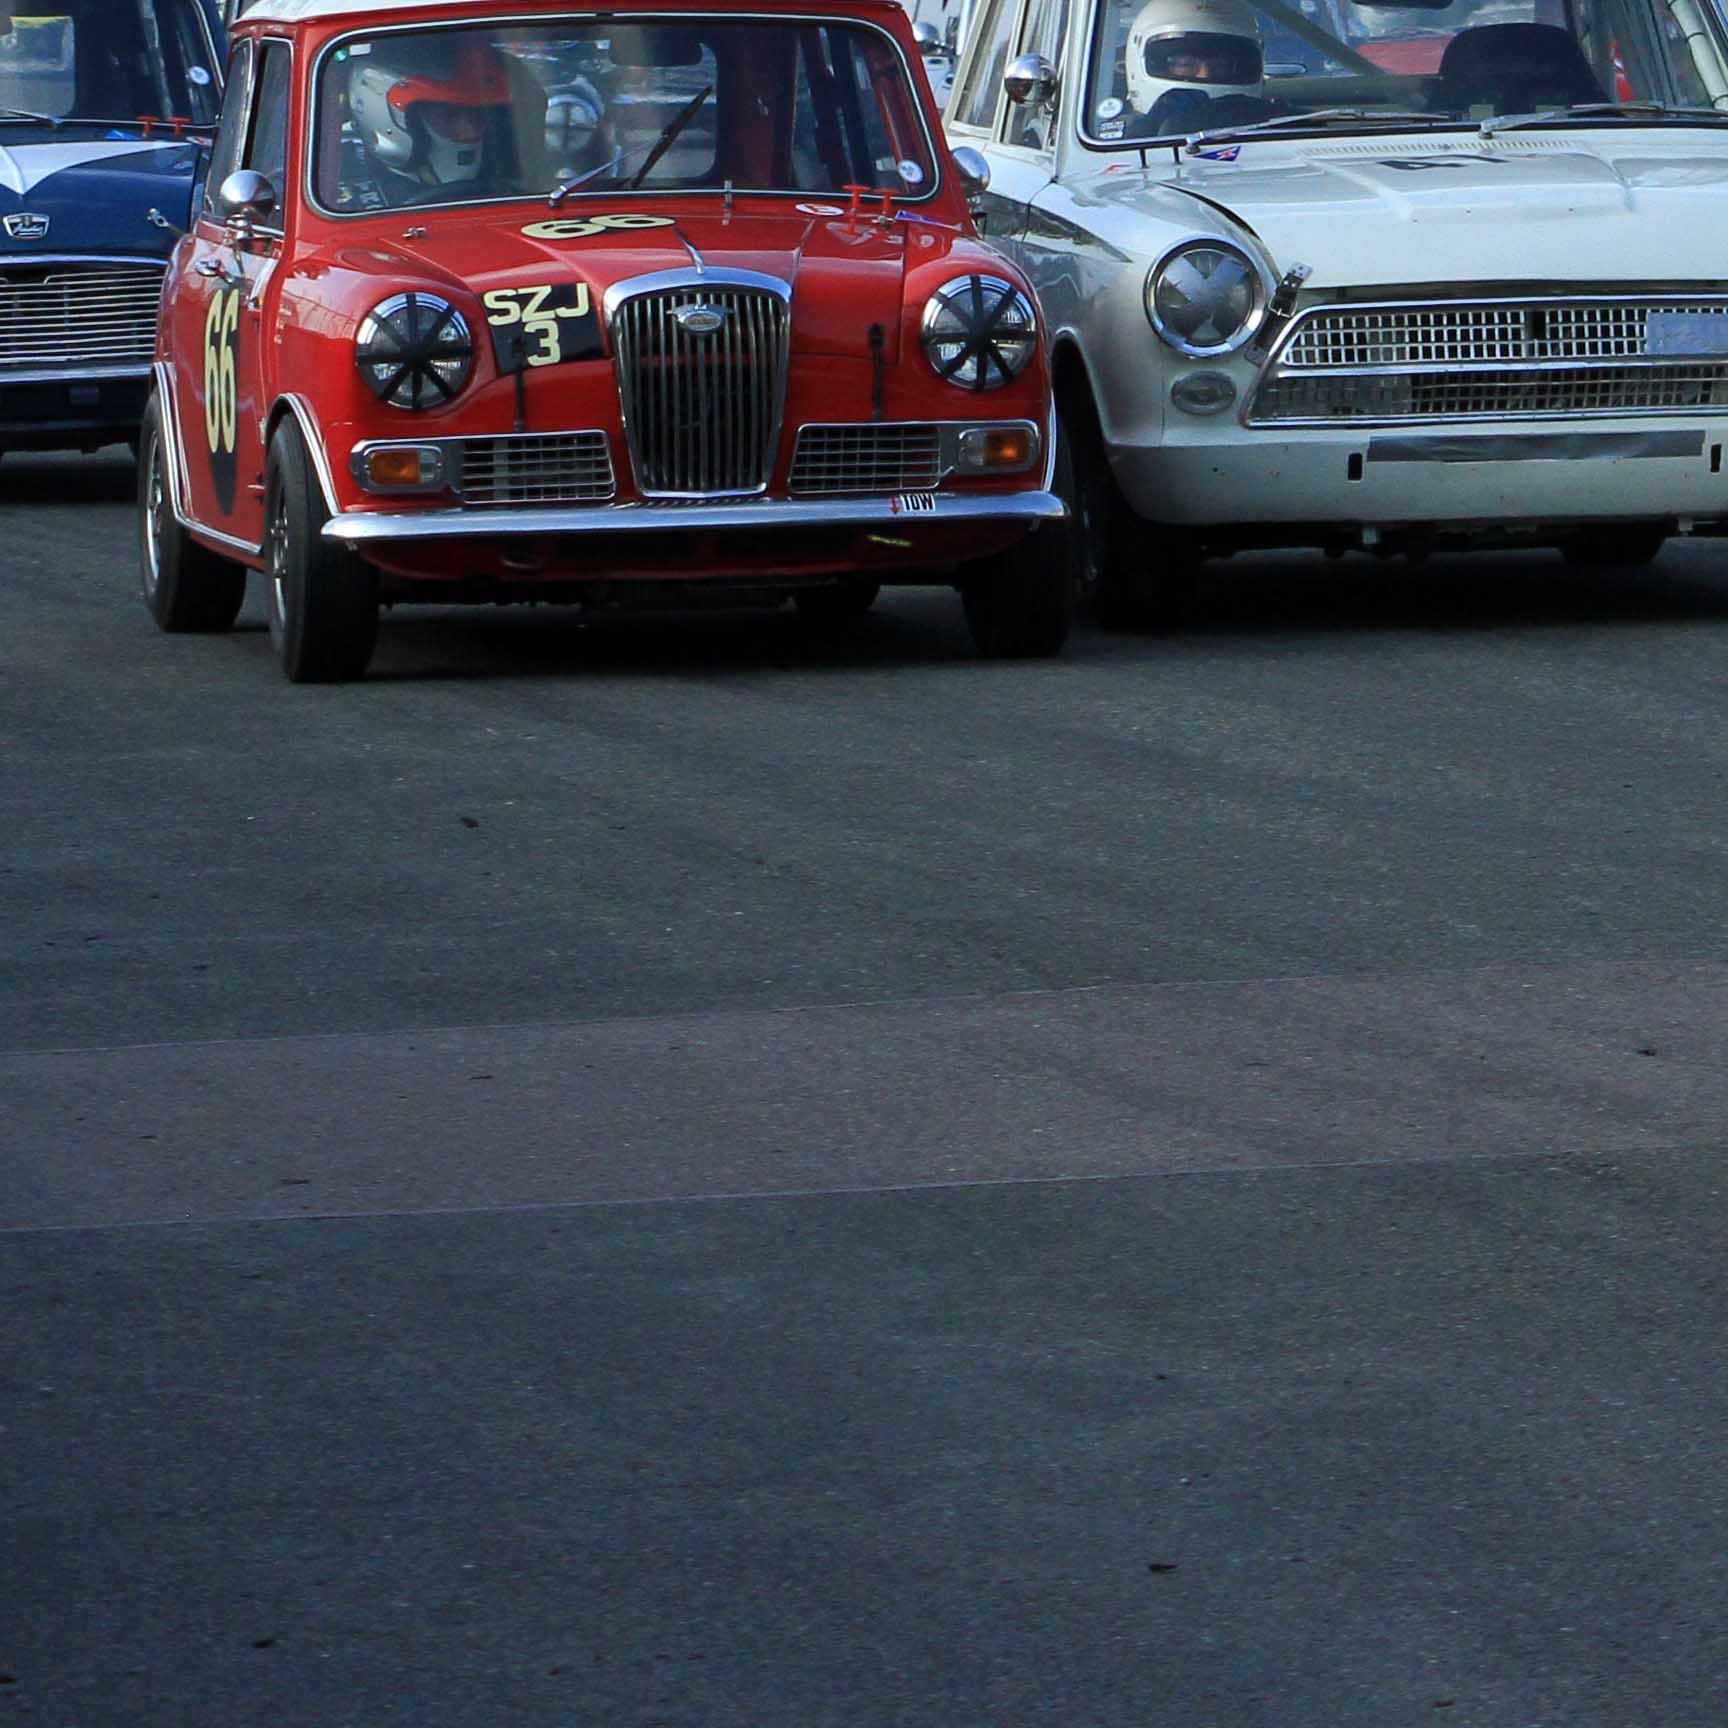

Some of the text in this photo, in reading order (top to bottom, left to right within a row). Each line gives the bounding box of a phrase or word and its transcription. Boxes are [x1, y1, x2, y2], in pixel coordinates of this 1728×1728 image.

[521, 214, 675, 239] 66
[483, 283, 589, 326] SZJ
[524, 321, 560, 366] 3
[205, 289, 240, 453] 66
[902, 494, 934, 511] TOW
